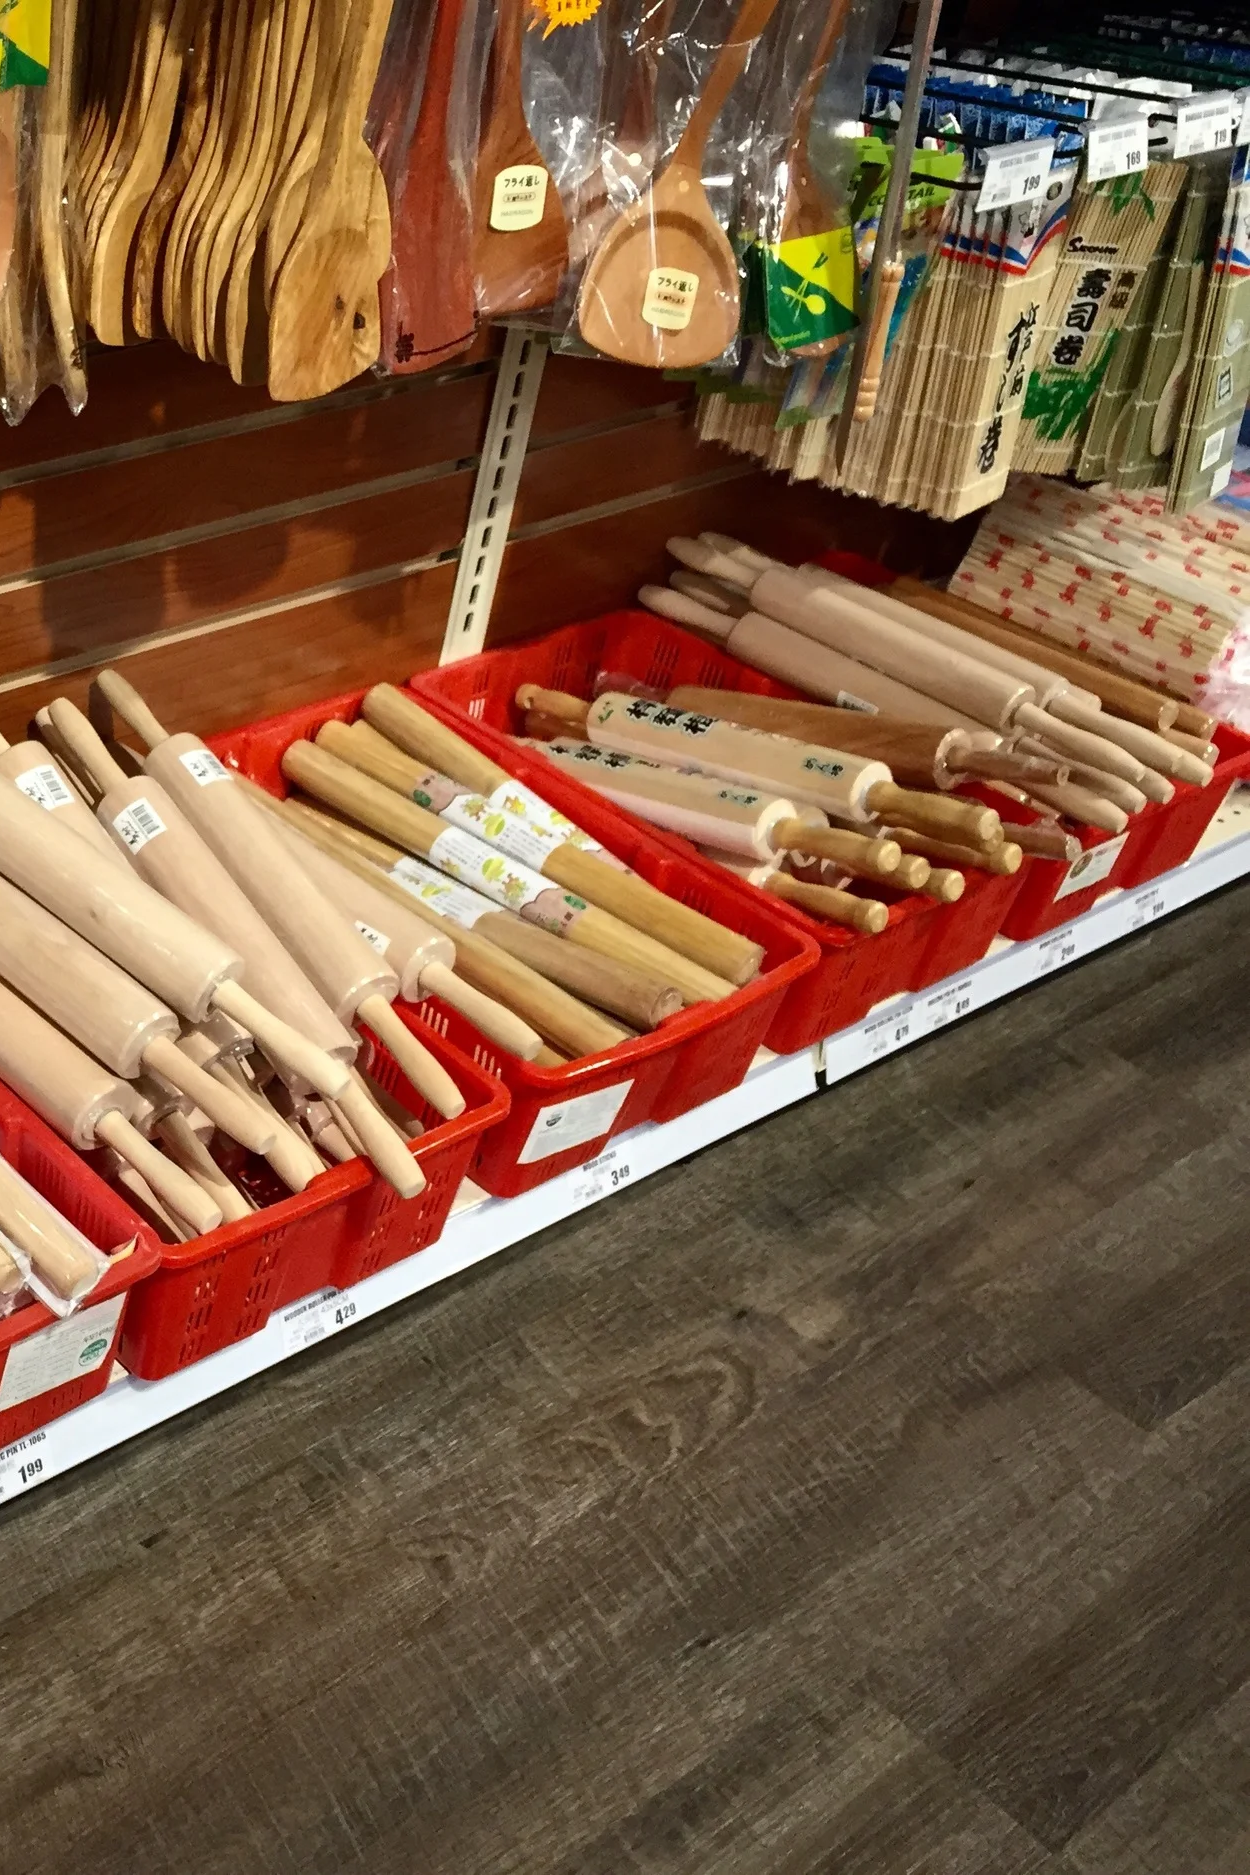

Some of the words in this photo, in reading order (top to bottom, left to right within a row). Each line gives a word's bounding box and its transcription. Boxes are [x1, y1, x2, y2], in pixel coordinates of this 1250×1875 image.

[1023, 174, 1042, 196] 199
[611, 1164, 630, 1186] 349
[335, 1302, 357, 1326] 429
[17, 1457, 44, 1485] 199
